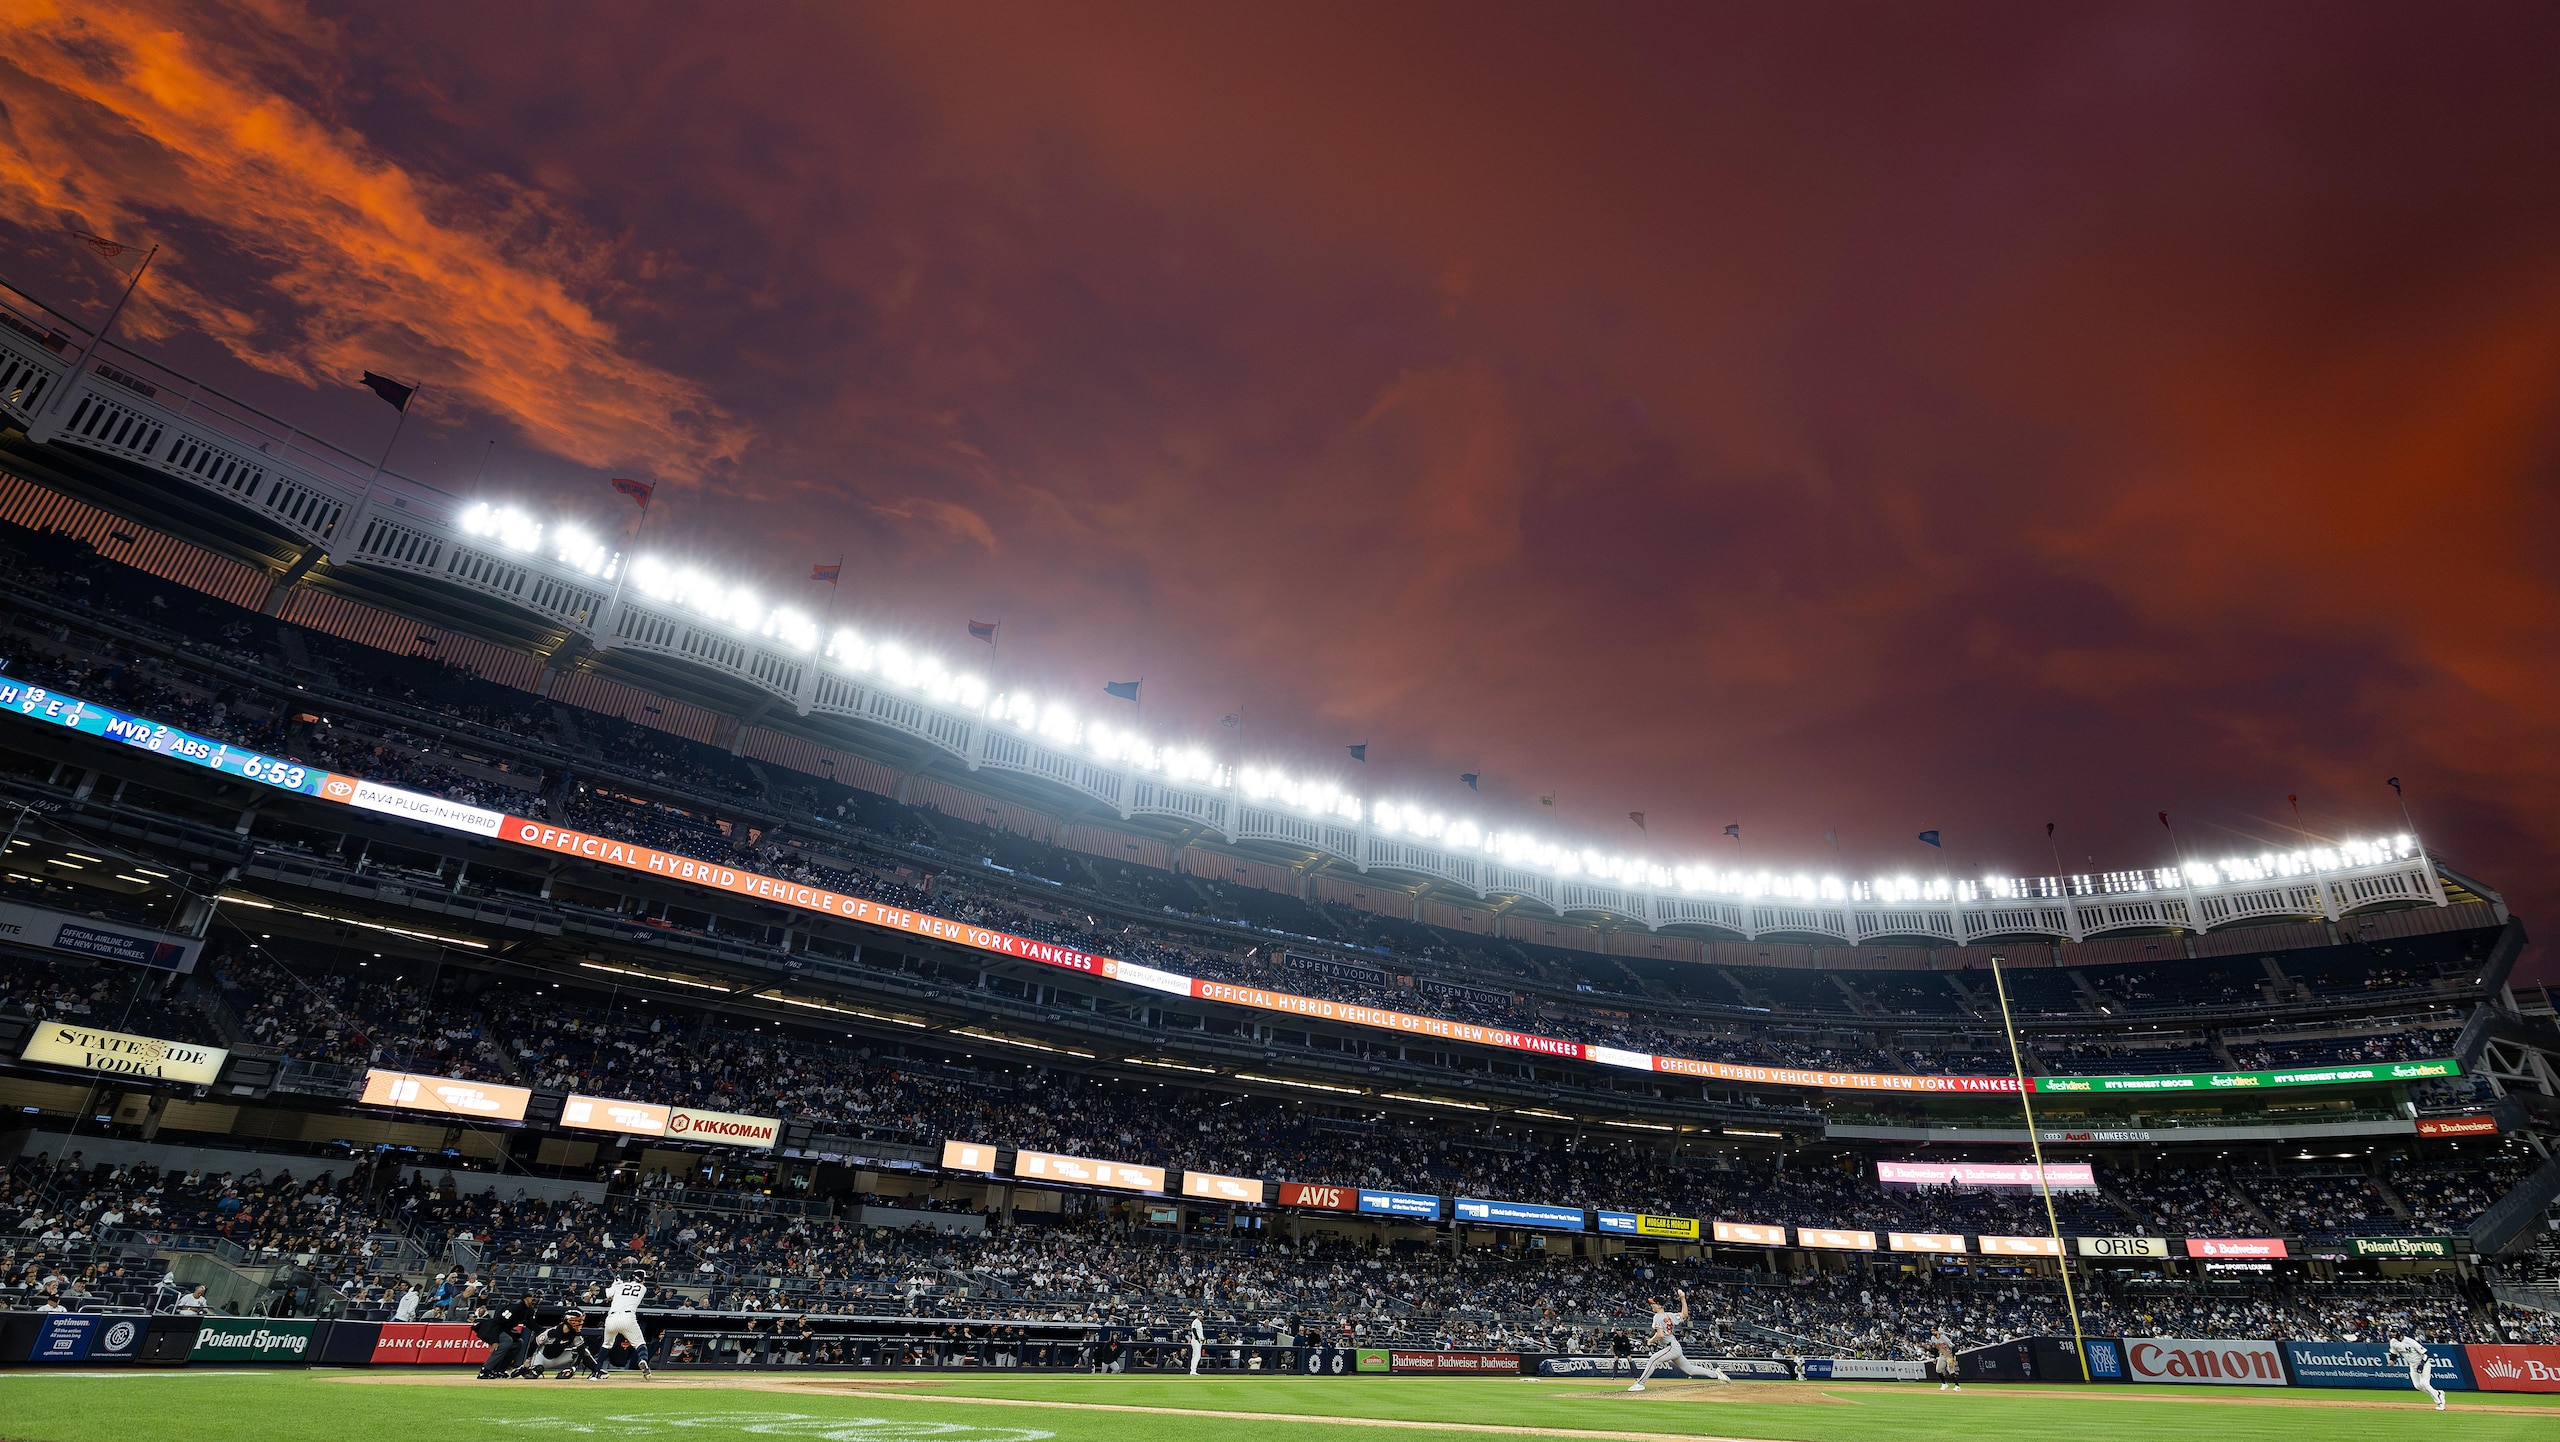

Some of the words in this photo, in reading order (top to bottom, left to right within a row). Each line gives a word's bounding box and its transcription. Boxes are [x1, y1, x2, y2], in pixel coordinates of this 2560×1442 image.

[0, 686, 18, 704] H
[24, 686, 46, 702] 13
[46, 700, 64, 717] E
[74, 701, 86, 714] 1
[106, 718, 151, 742] MVR
[153, 725, 168, 739] 2
[170, 738, 210, 760] ABS
[218, 744, 228, 756] 1
[243, 755, 306, 788] 6:53
[22, 700, 35, 714] 9
[66, 714, 80, 727] 0
[148, 738, 162, 750] 0
[210, 756, 223, 768] 0
[358, 788, 393, 805] RAV4
[394, 798, 448, 819] PLUG-IN
[450, 808, 496, 830] HYBRID
[520, 824, 638, 866] OFFICIAL
[648, 854, 736, 887] HYBRID
[744, 876, 834, 911] VEHICLE
[841, 900, 869, 918] OF
[876, 908, 912, 929] THE
[918, 917, 960, 940] NEW
[967, 930, 1014, 952] YORK
[1020, 940, 1092, 971] YANKEES
[62, 928, 94, 941] OFFICIAL
[95, 934, 123, 945] AIRLINE
[58, 936, 73, 946] THE
[74, 939, 91, 948] NEW
[93, 943, 113, 954] YORK
[1290, 958, 1328, 973] ASPEN
[1343, 968, 1380, 983] VODKA
[1426, 984, 1460, 996] ASPEN
[1473, 991, 1506, 1004] VODKA
[1202, 984, 1272, 1007] OFFICIAL
[1278, 996, 1332, 1016] HYBRID
[1338, 1006, 1396, 1027] VEHICLE
[1402, 1016, 1420, 1030] OF
[1424, 1020, 1449, 1034] THE
[1454, 1026, 1483, 1040] NEW
[1488, 1031, 1521, 1046] YORK
[1525, 1036, 1578, 1056] YANKEES
[55, 1028, 206, 1065] STATESIDE
[84, 1052, 162, 1078] VODKA
[1660, 1059, 1716, 1076] OFFICIAL
[1720, 1066, 1766, 1080] HYBRID
[1770, 1070, 1824, 1084] VEHICLE
[1829, 1075, 1846, 1086] OF
[1852, 1076, 1877, 1087] THE
[1883, 1077, 1913, 1088] NEW
[1918, 1078, 1954, 1090] YORK
[1961, 1079, 2024, 1091] YANKEES
[2046, 1079, 2092, 1090] freshdirect
[2210, 1076, 2260, 1087] freshdirect
[2337, 1070, 2374, 1080] GROCER
[2392, 1064, 2448, 1077] freshdirect
[693, 1119, 772, 1139] KIKKOMAN
[2439, 1122, 2494, 1133] Budweiser
[2065, 1132, 2090, 1141] Audi
[2093, 1132, 2129, 1141] YANKEES
[2130, 1132, 2150, 1140] CLUB
[1896, 1168, 1945, 1179] Budweiser
[1965, 1169, 2016, 1180] Budweiser
[1297, 1186, 1339, 1208] AVIS
[1646, 1218, 1667, 1228] MORGAN
[1670, 1220, 1690, 1229] MORGAN
[2094, 1239, 2150, 1255] ORIS
[2218, 1243, 2269, 1254] Budweiser
[2356, 1239, 2400, 1254] Poland
[2398, 1239, 2444, 1255] Spring
[620, 1285, 641, 1297] 22
[194, 1328, 256, 1349] Poland
[254, 1330, 308, 1353] Spring
[378, 1339, 414, 1348] BANK
[416, 1340, 428, 1348] OF
[429, 1340, 490, 1349] AMERICA
[2060, 1341, 2075, 1350] 318
[2091, 1345, 2112, 1355] NEW
[1392, 1354, 1434, 1367] Budweiser
[1438, 1354, 1478, 1368] Budweiser
[1480, 1354, 1519, 1368] Budweiser
[1570, 1360, 1593, 1371] COOL
[2090, 1353, 2116, 1364] YORK
[2130, 1343, 2280, 1379] Canon
[2293, 1350, 2382, 1367] Montefiore
[2384, 1352, 2454, 1368] Einein
[1734, 1363, 1753, 1372] COOL
[1769, 1364, 1789, 1374] COOL
[2095, 1362, 2116, 1372] LIFE
